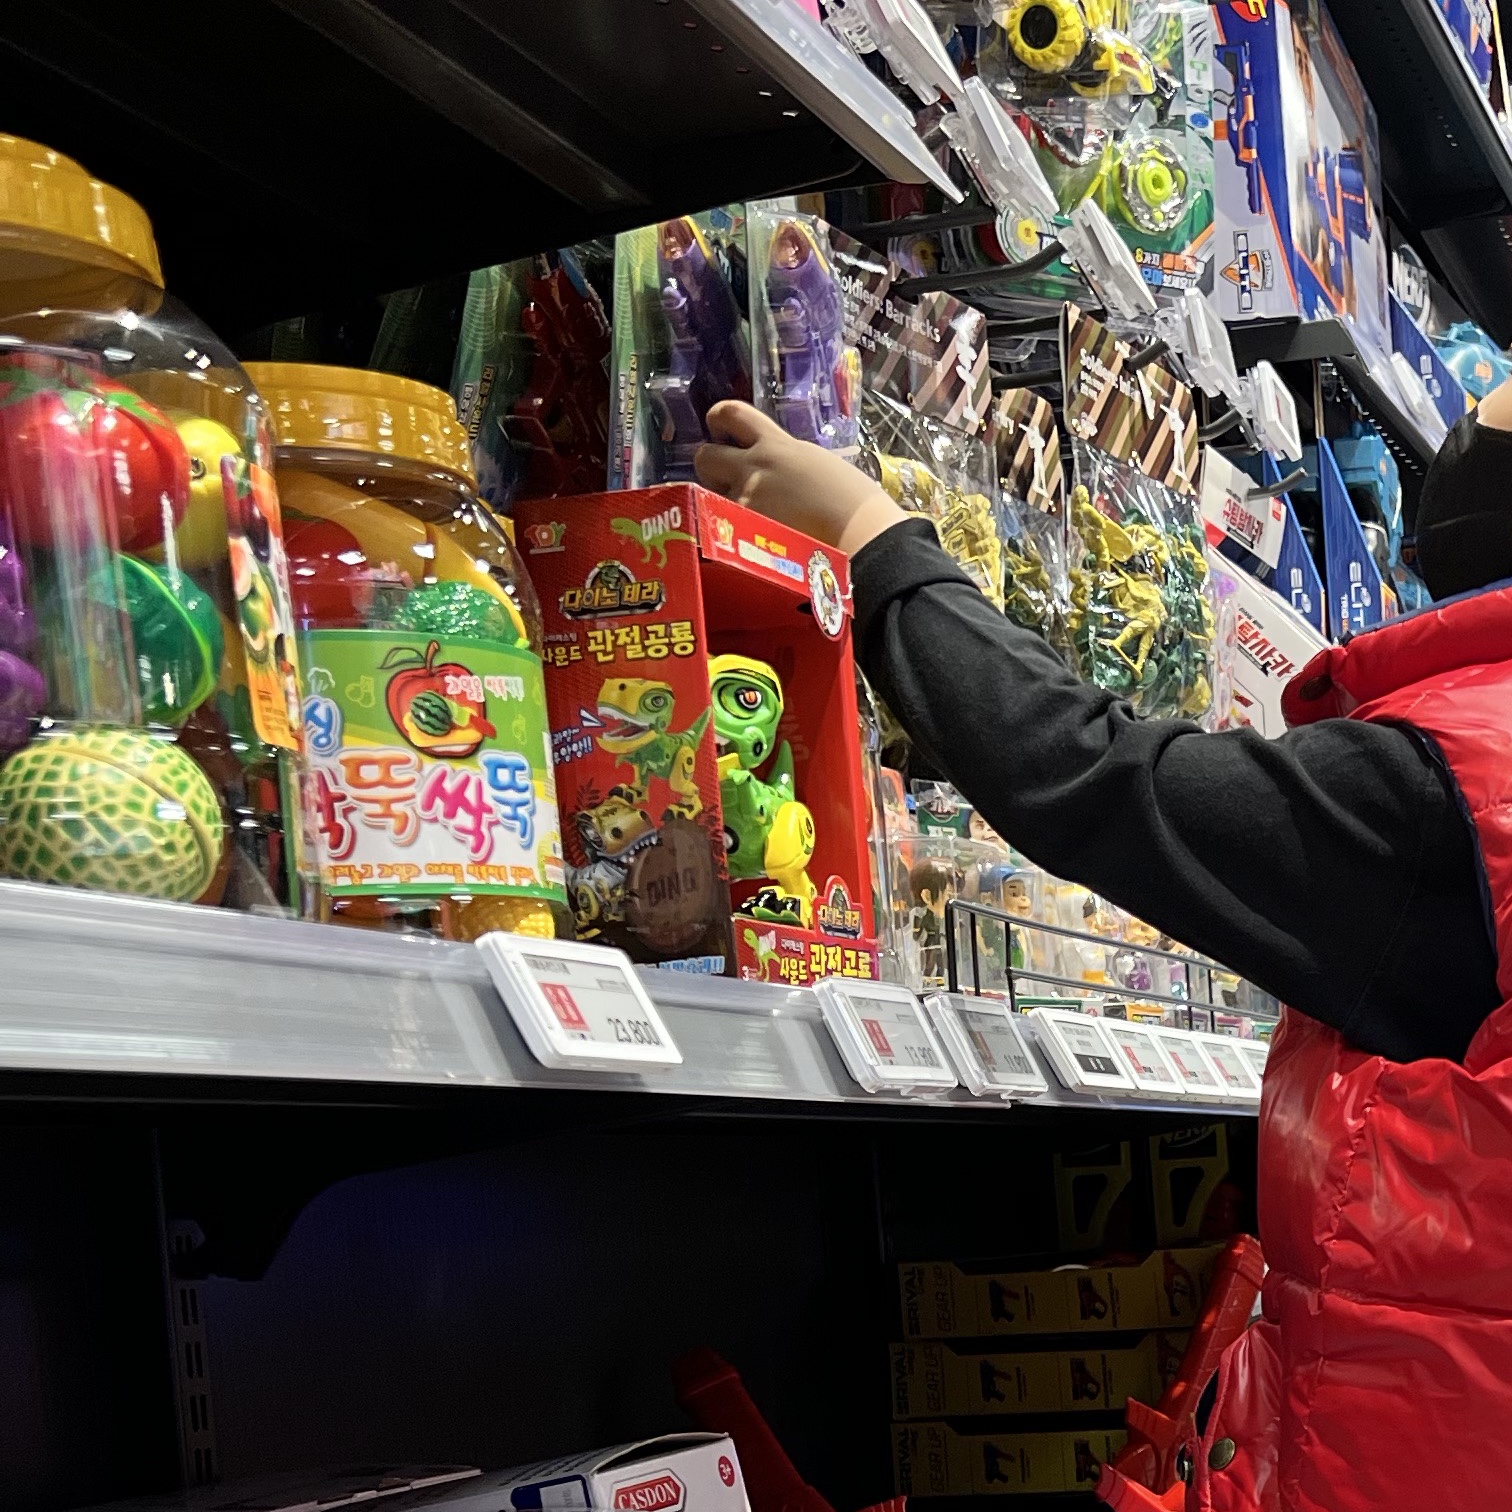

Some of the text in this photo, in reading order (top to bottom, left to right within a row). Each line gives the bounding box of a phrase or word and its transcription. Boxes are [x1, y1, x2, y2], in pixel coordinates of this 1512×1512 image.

[885, 299, 941, 343] Barracks
[640, 506, 683, 541] DINO
[563, 586, 622, 612] 다이노
[586, 620, 697, 664] 관절공룡
[618, 1482, 677, 1512] CASDON
